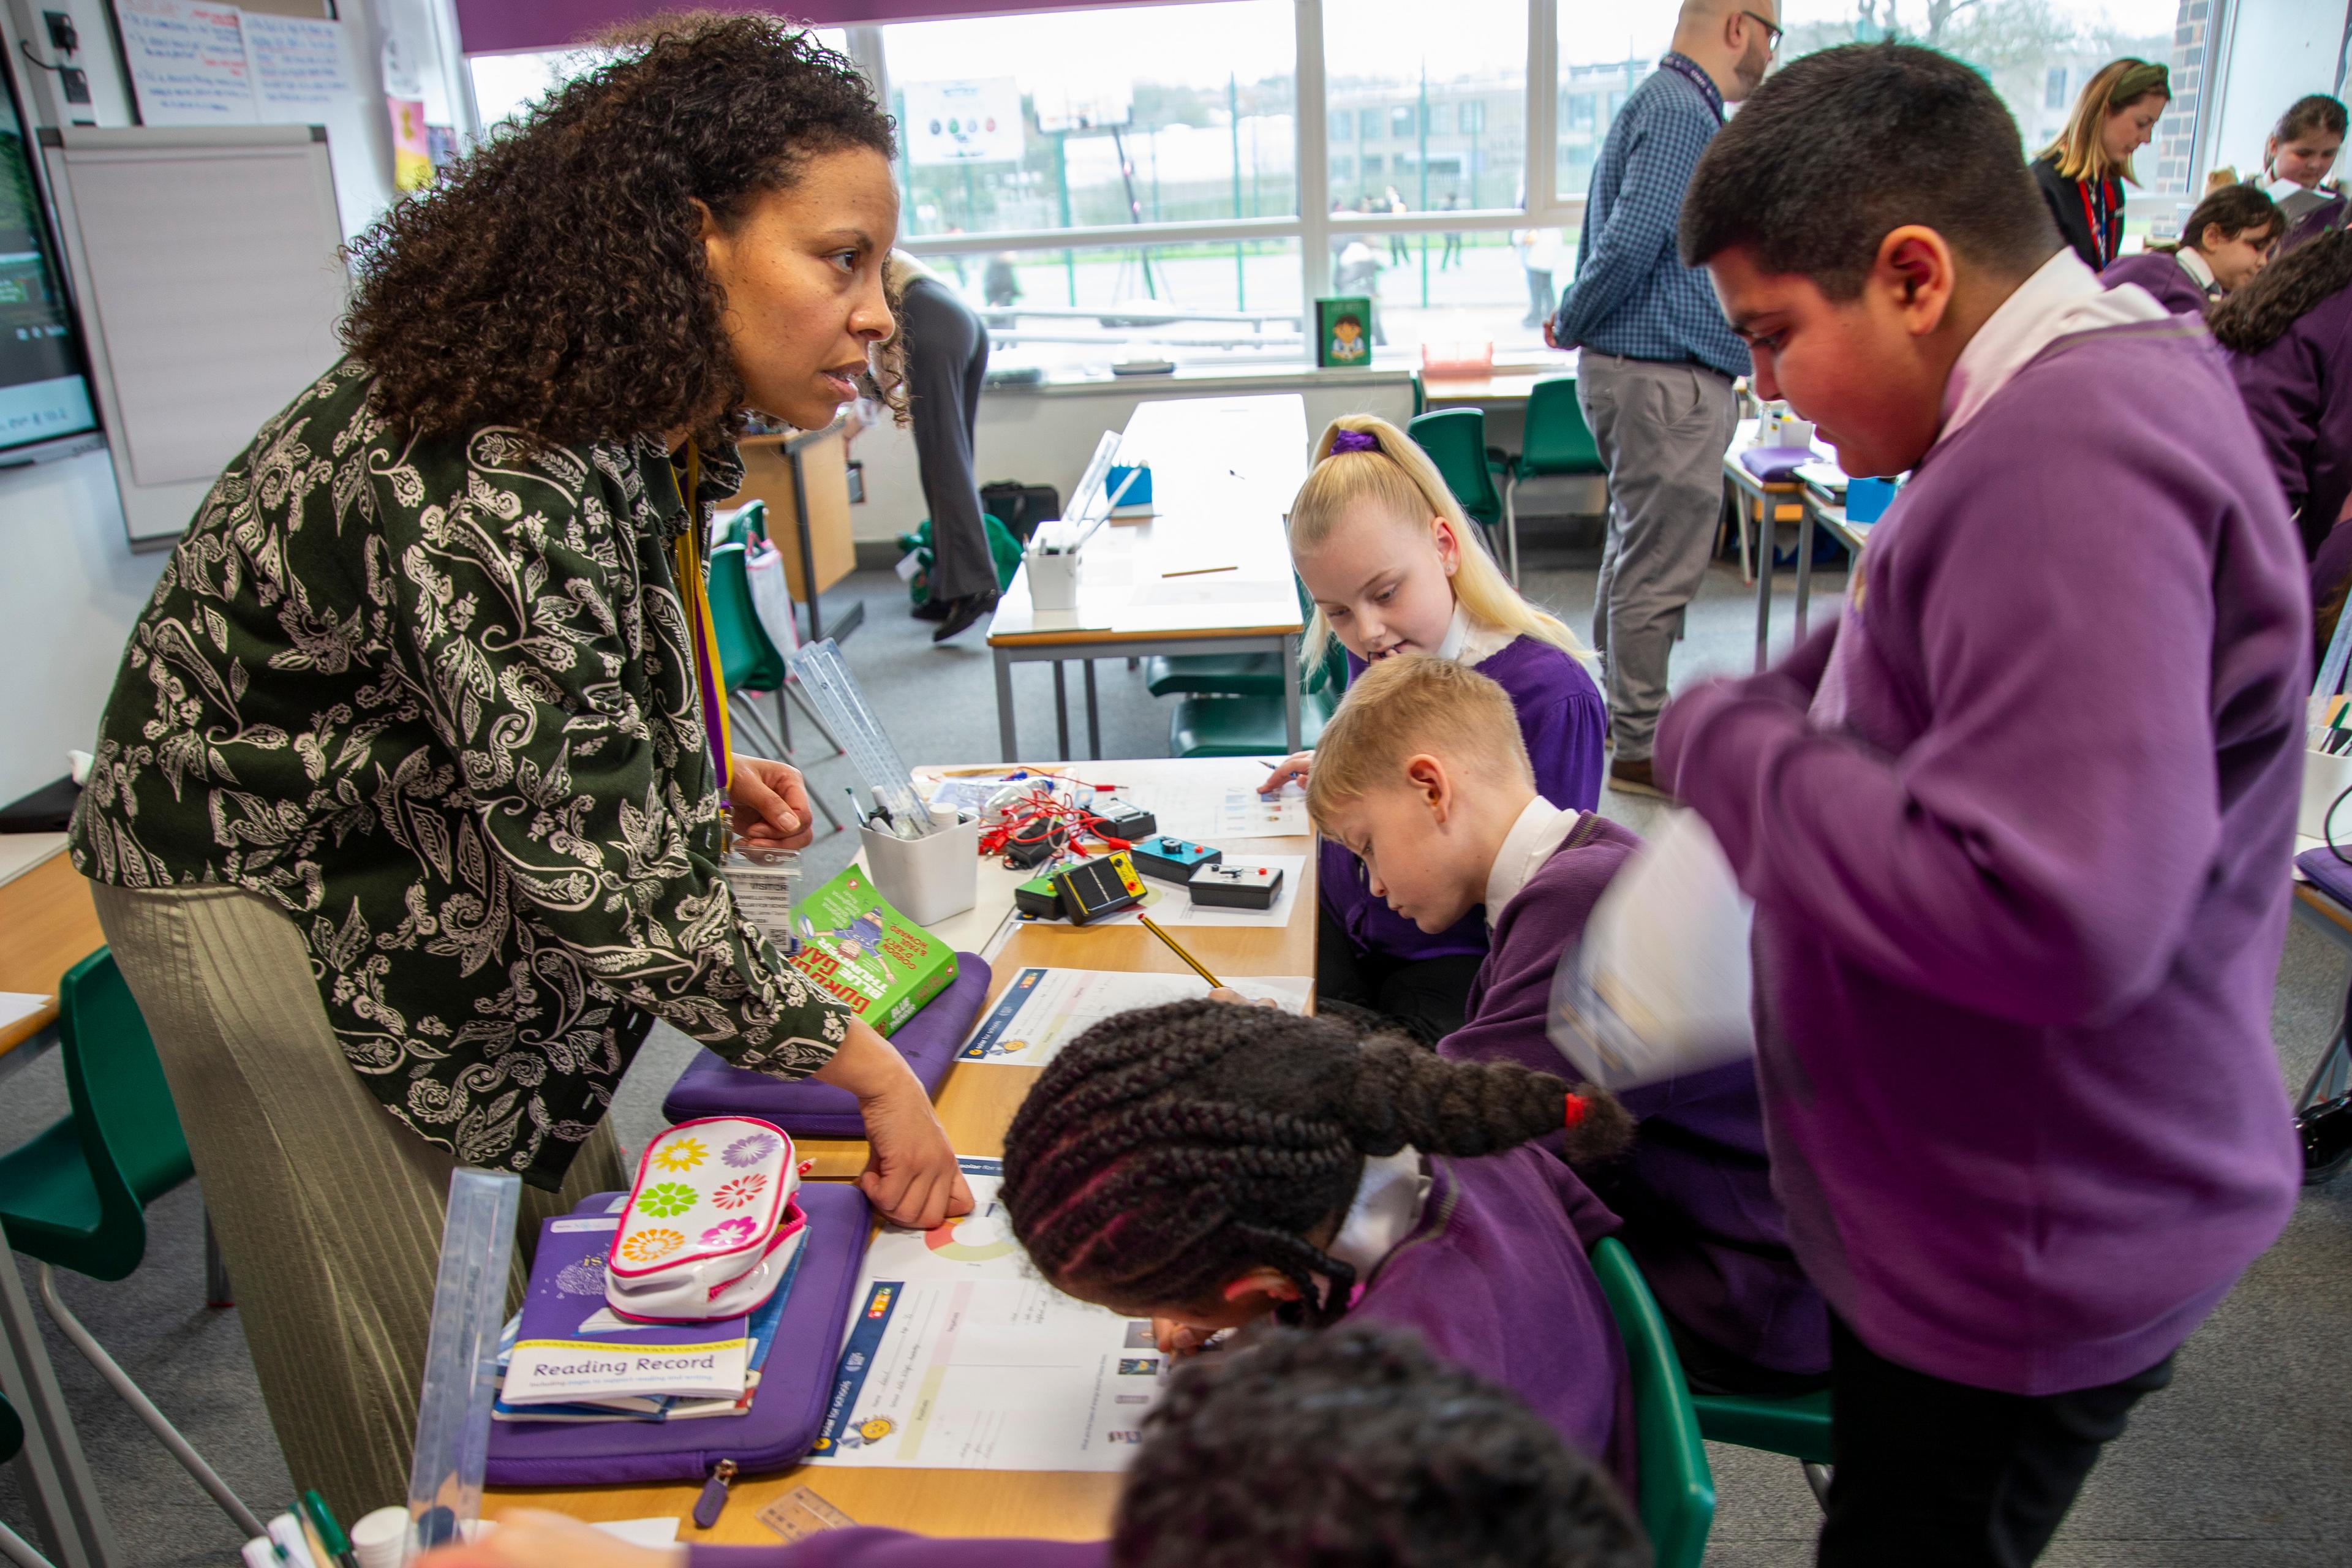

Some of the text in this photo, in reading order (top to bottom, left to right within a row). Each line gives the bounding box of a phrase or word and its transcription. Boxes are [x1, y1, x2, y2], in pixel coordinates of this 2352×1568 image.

[750, 883, 788, 891] VISITOR
[889, 925, 927, 949] HOWARD
[816, 937, 888, 993] THUNDER
[882, 944, 916, 970] GORDON
[837, 966, 884, 1000] BLUE
[533, 1354, 715, 1377] Reading Record
[821, 1379, 852, 1438] solar for schools
